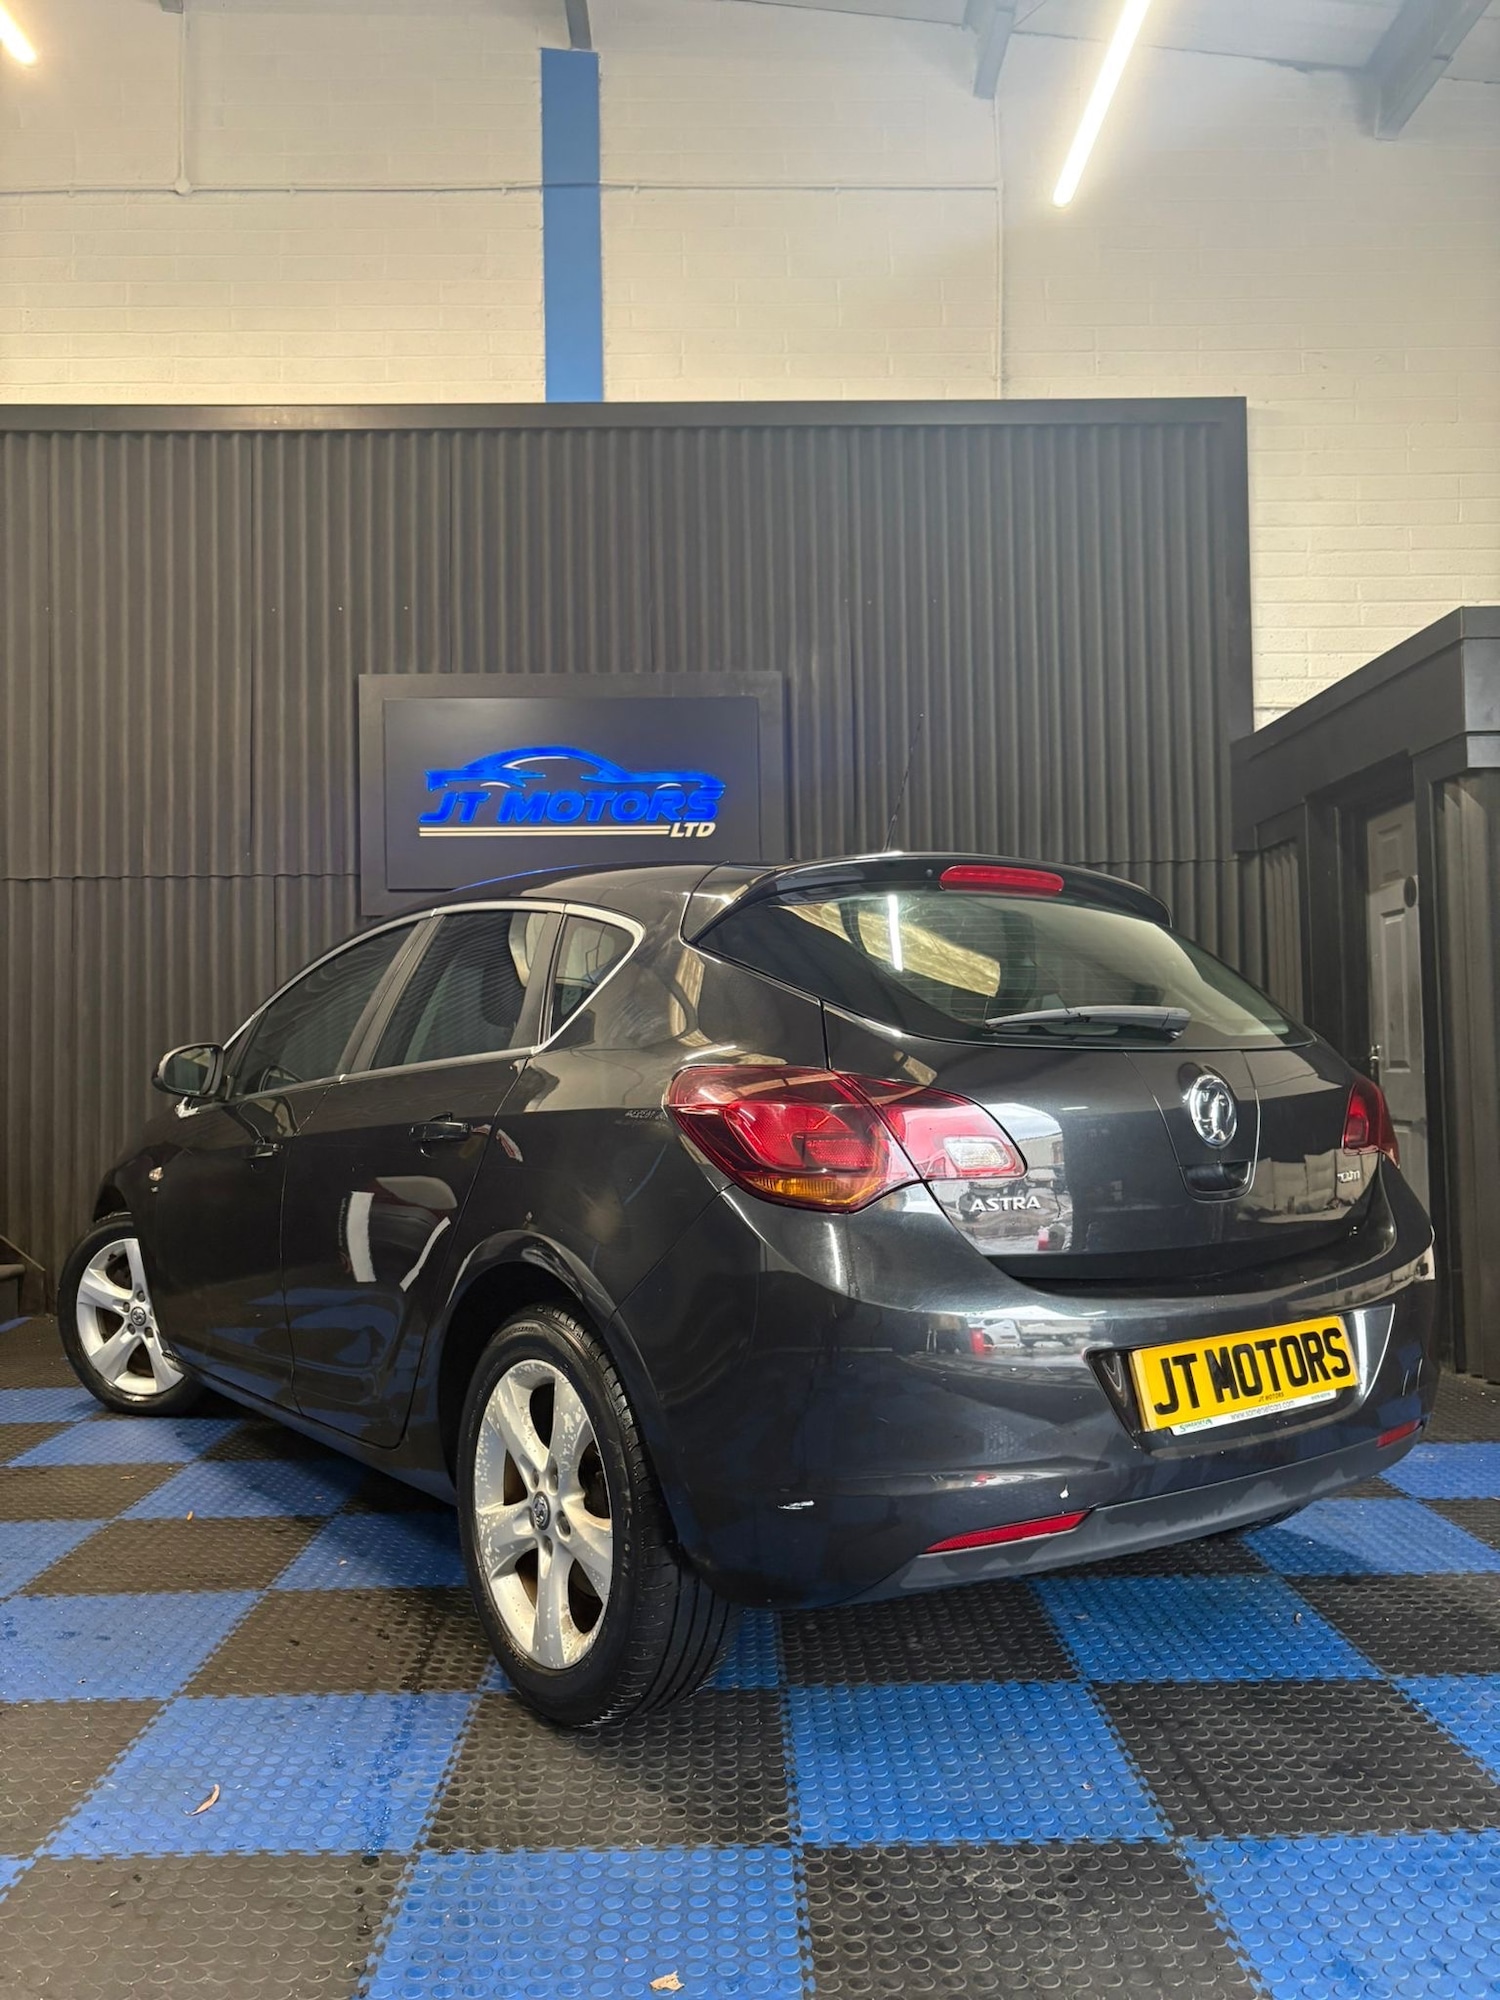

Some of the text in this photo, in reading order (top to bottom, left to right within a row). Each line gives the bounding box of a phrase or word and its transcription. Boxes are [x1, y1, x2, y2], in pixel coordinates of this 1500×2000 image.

[419, 789, 725, 823] JT MOTORS
[670, 822, 716, 838] LTD
[969, 1196, 1041, 1212] ASTRA
[1153, 1326, 1352, 1416] JT MOTORS
[1265, 1392, 1285, 1401] MOTORS
